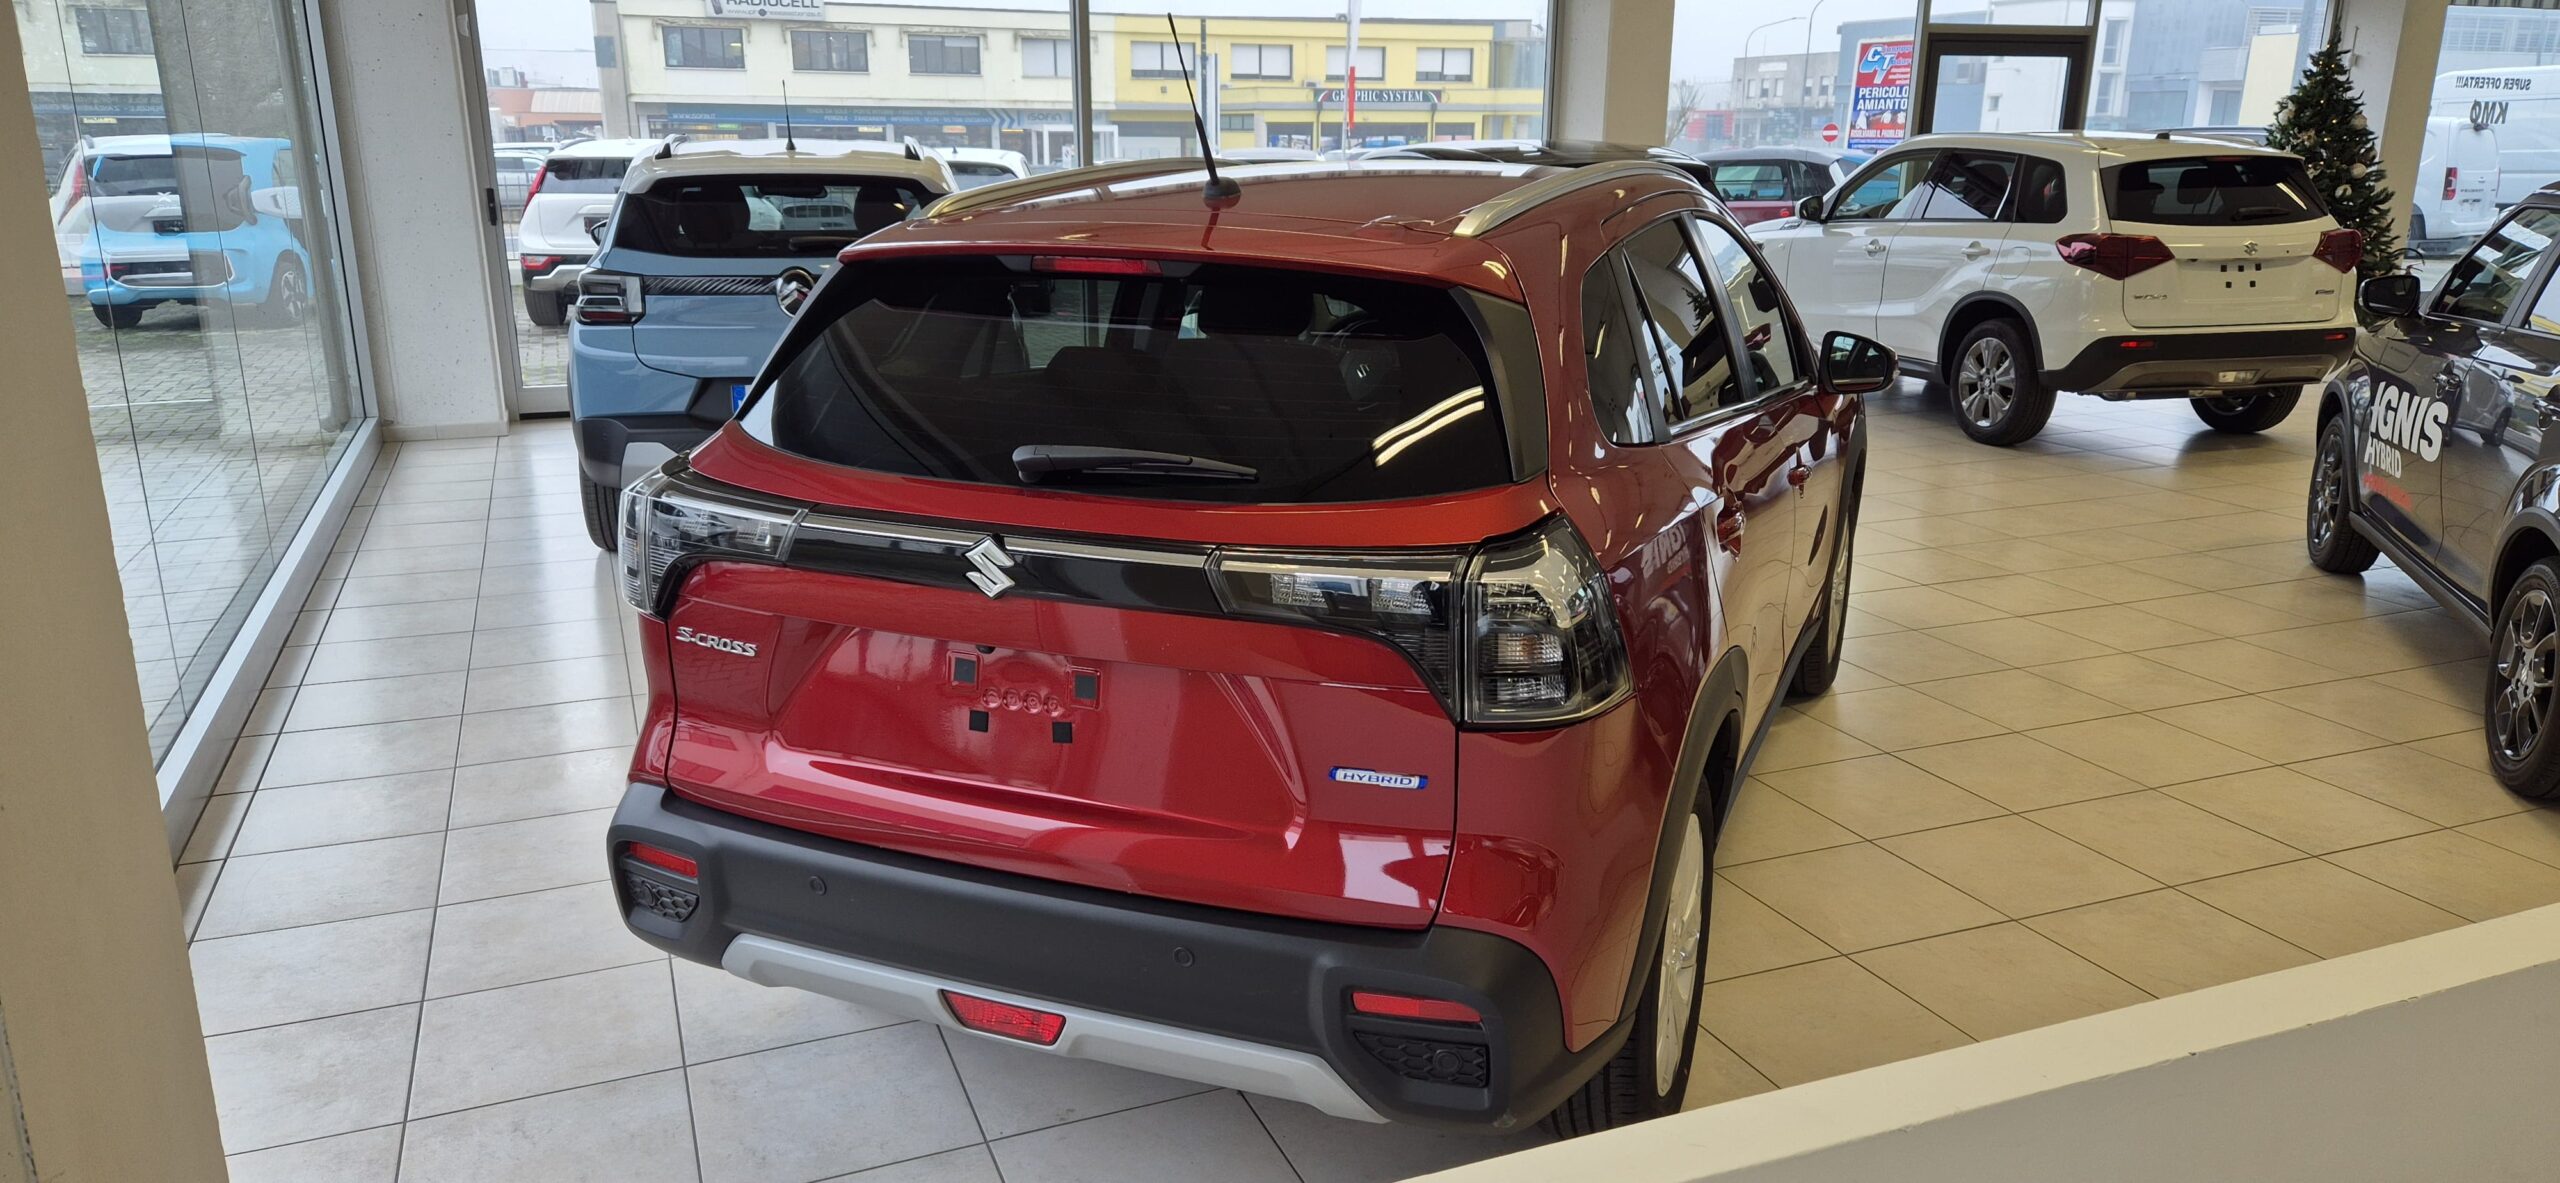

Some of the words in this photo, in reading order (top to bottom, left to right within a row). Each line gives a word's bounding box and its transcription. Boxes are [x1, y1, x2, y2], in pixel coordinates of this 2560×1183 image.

[1332, 90, 1381, 102] GRPHIC
[1383, 90, 1424, 102] SYSTEM
[1859, 86, 1909, 98] PERICOLO
[1857, 98, 1908, 110] AMIANTO
[2370, 381, 2449, 462] IGNIS
[2363, 438, 2402, 479] HYBRID
[1343, 772, 1412, 786] HYBRID
